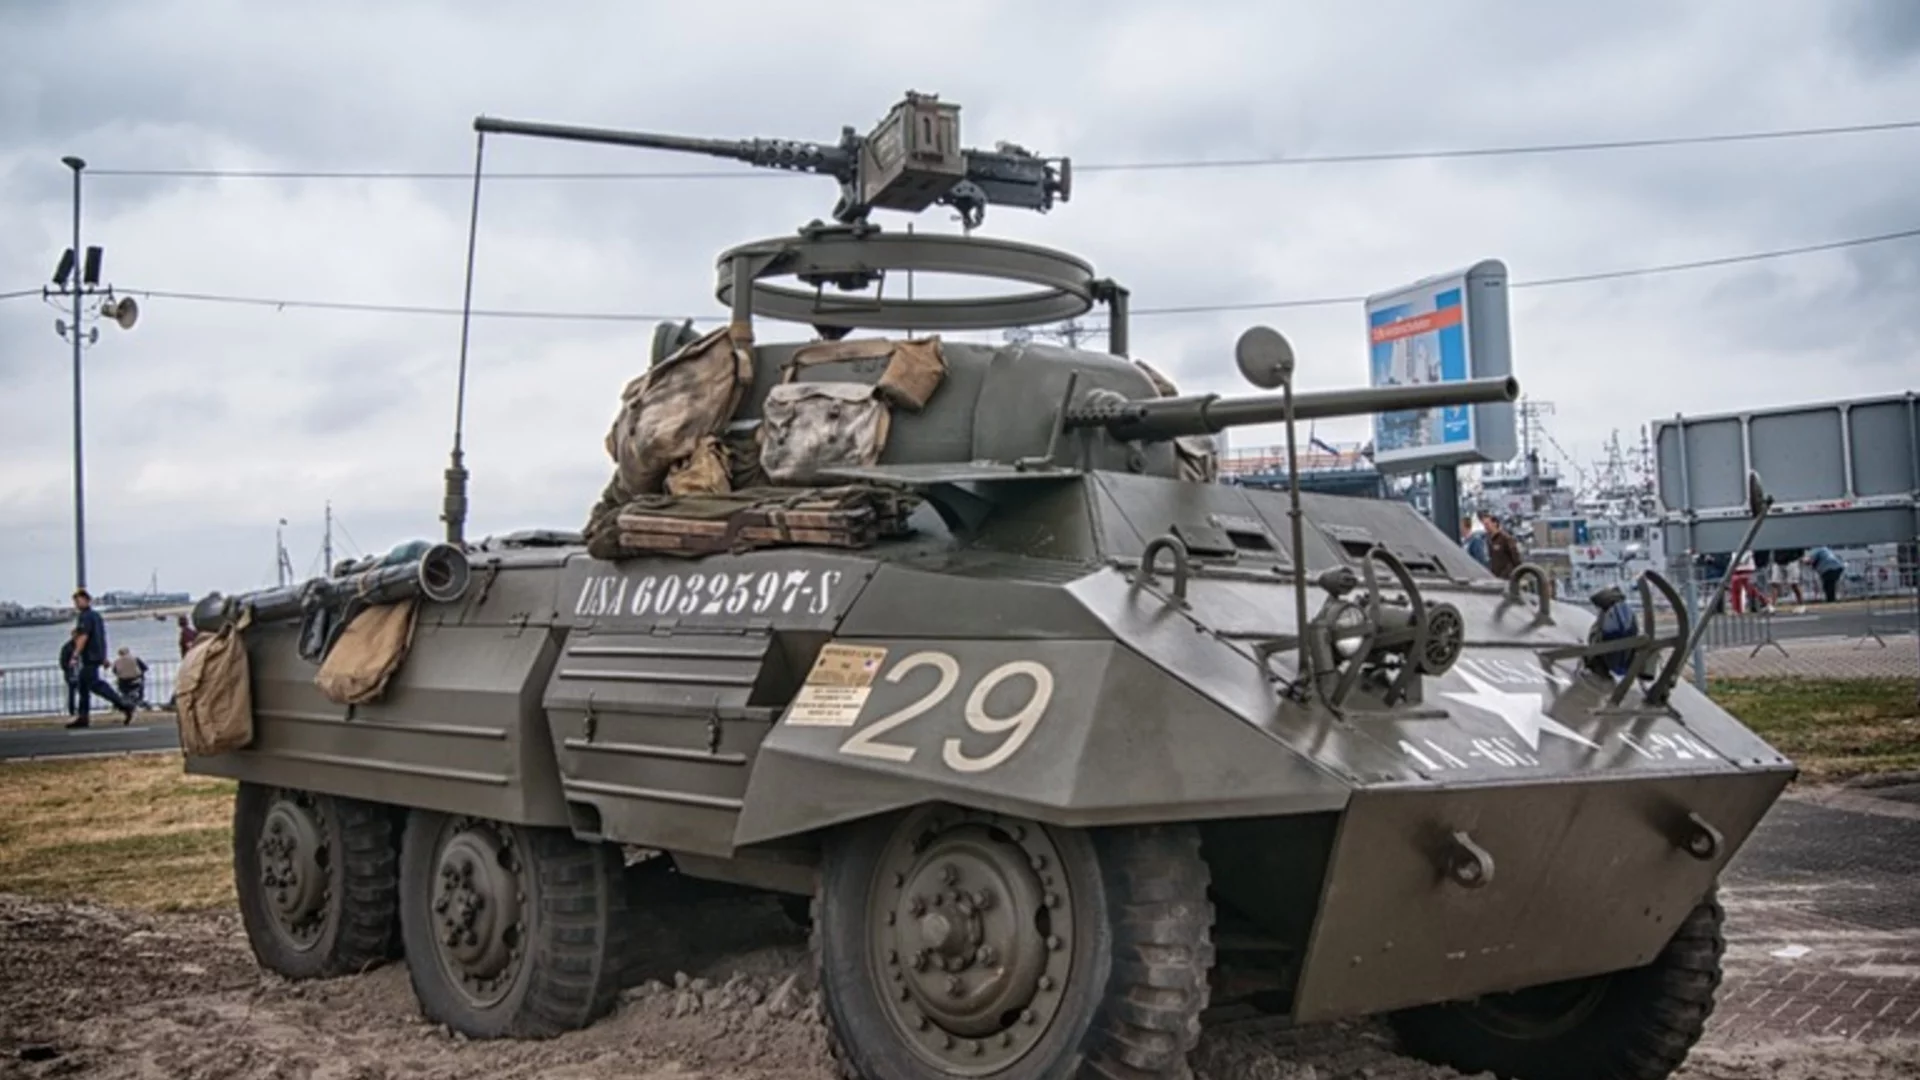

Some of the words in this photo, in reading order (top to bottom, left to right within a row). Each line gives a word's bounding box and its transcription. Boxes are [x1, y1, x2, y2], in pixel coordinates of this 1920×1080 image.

[574, 576, 627, 615] USA
[631, 570, 841, 616] 6032597-S
[839, 651, 1054, 772] 29
